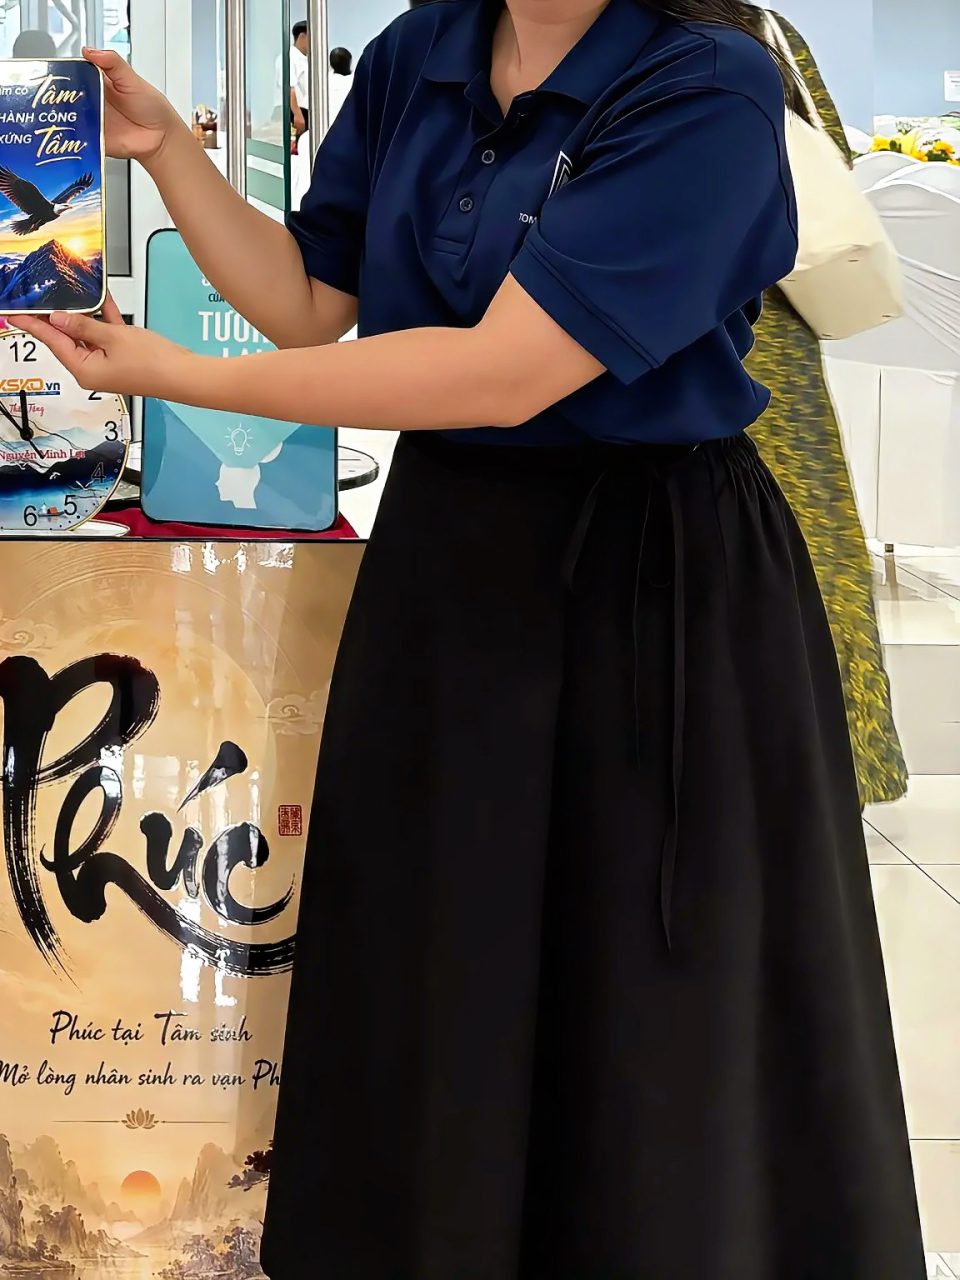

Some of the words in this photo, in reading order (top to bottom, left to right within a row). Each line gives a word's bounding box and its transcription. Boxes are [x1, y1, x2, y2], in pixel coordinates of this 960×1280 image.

[29, 73, 84, 110] Tâm
[38, 109, 77, 123] CÔNG
[34, 124, 88, 159] Tầm
[518, 212, 537, 224] TOM
[9, 340, 37, 362] 12
[105, 420, 119, 442] 3
[91, 461, 105, 483] 4
[23, 505, 38, 527] 6
[64, 495, 78, 516] 5
[49, 1009, 106, 1045] Phúc
[110, 1018, 144, 1046] tại
[153, 1009, 203, 1046] Tâm
[36, 1058, 78, 1096] lòng
[84, 1060, 134, 1086] nhân
[137, 1060, 177, 1086] sinh
[182, 1072, 206, 1086] ra
[211, 1072, 246, 1090] vạn
